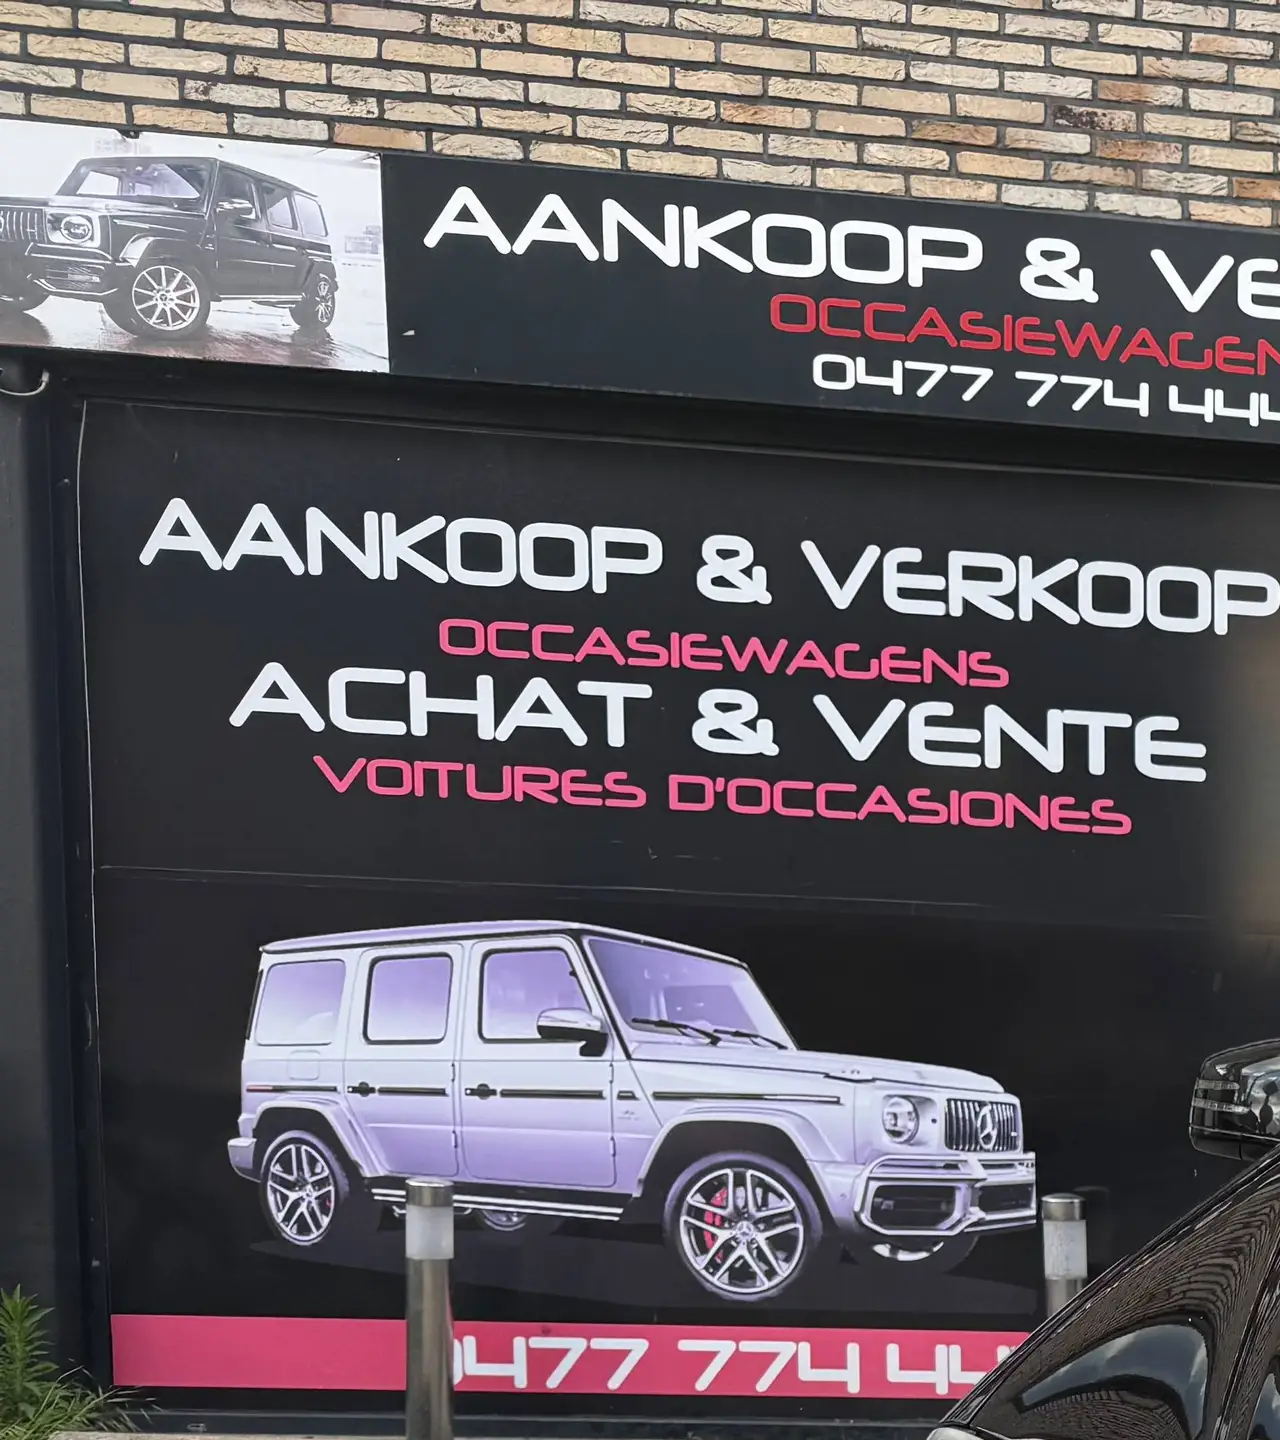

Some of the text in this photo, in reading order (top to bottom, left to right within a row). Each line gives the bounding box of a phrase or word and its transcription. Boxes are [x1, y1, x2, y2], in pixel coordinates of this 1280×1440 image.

[422, 184, 985, 289] AANKOOP
[1019, 237, 1099, 304] &
[812, 353, 994, 402] 0477
[1014, 370, 1150, 418] 774
[138, 497, 663, 594] AANKOOP
[696, 534, 773, 605] &
[439, 618, 1010, 688] OCCASIEWAGENS
[228, 661, 1207, 783] ACHAT & VENTE
[313, 755, 1133, 835] VOITURES D'OCCASIONES
[452, 1335, 1018, 1396] 477 774 44
